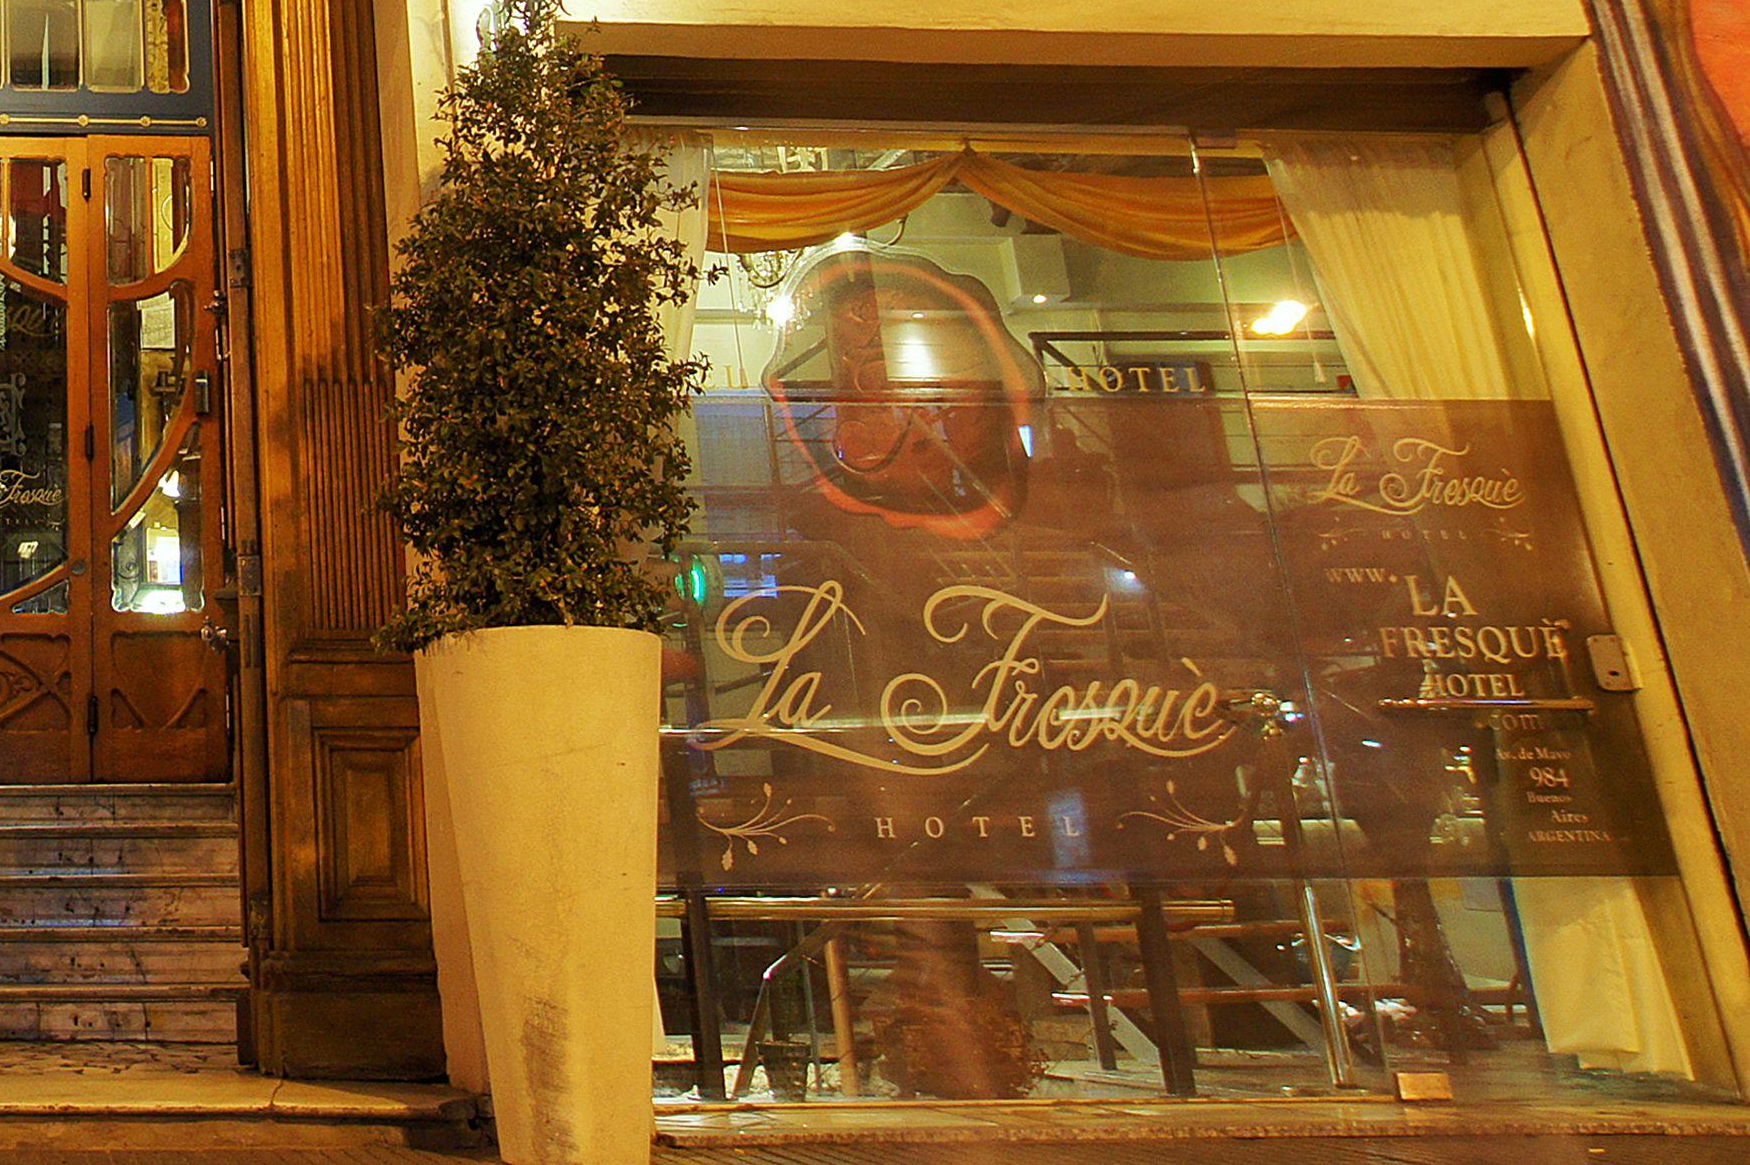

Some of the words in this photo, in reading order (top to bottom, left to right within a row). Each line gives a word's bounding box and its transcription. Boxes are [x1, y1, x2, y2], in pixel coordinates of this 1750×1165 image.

[1305, 435, 1425, 516] La
[1404, 574, 1480, 617] LA
[688, 579, 990, 776] La
[1519, 746, 1534, 761] de
[1529, 766, 1571, 788] 984
[1526, 790, 1573, 804] Buenos
[875, 815, 1082, 839] HOTEL
[1550, 808, 1590, 824] Aires
[1527, 829, 1612, 843] ARGENTINA
